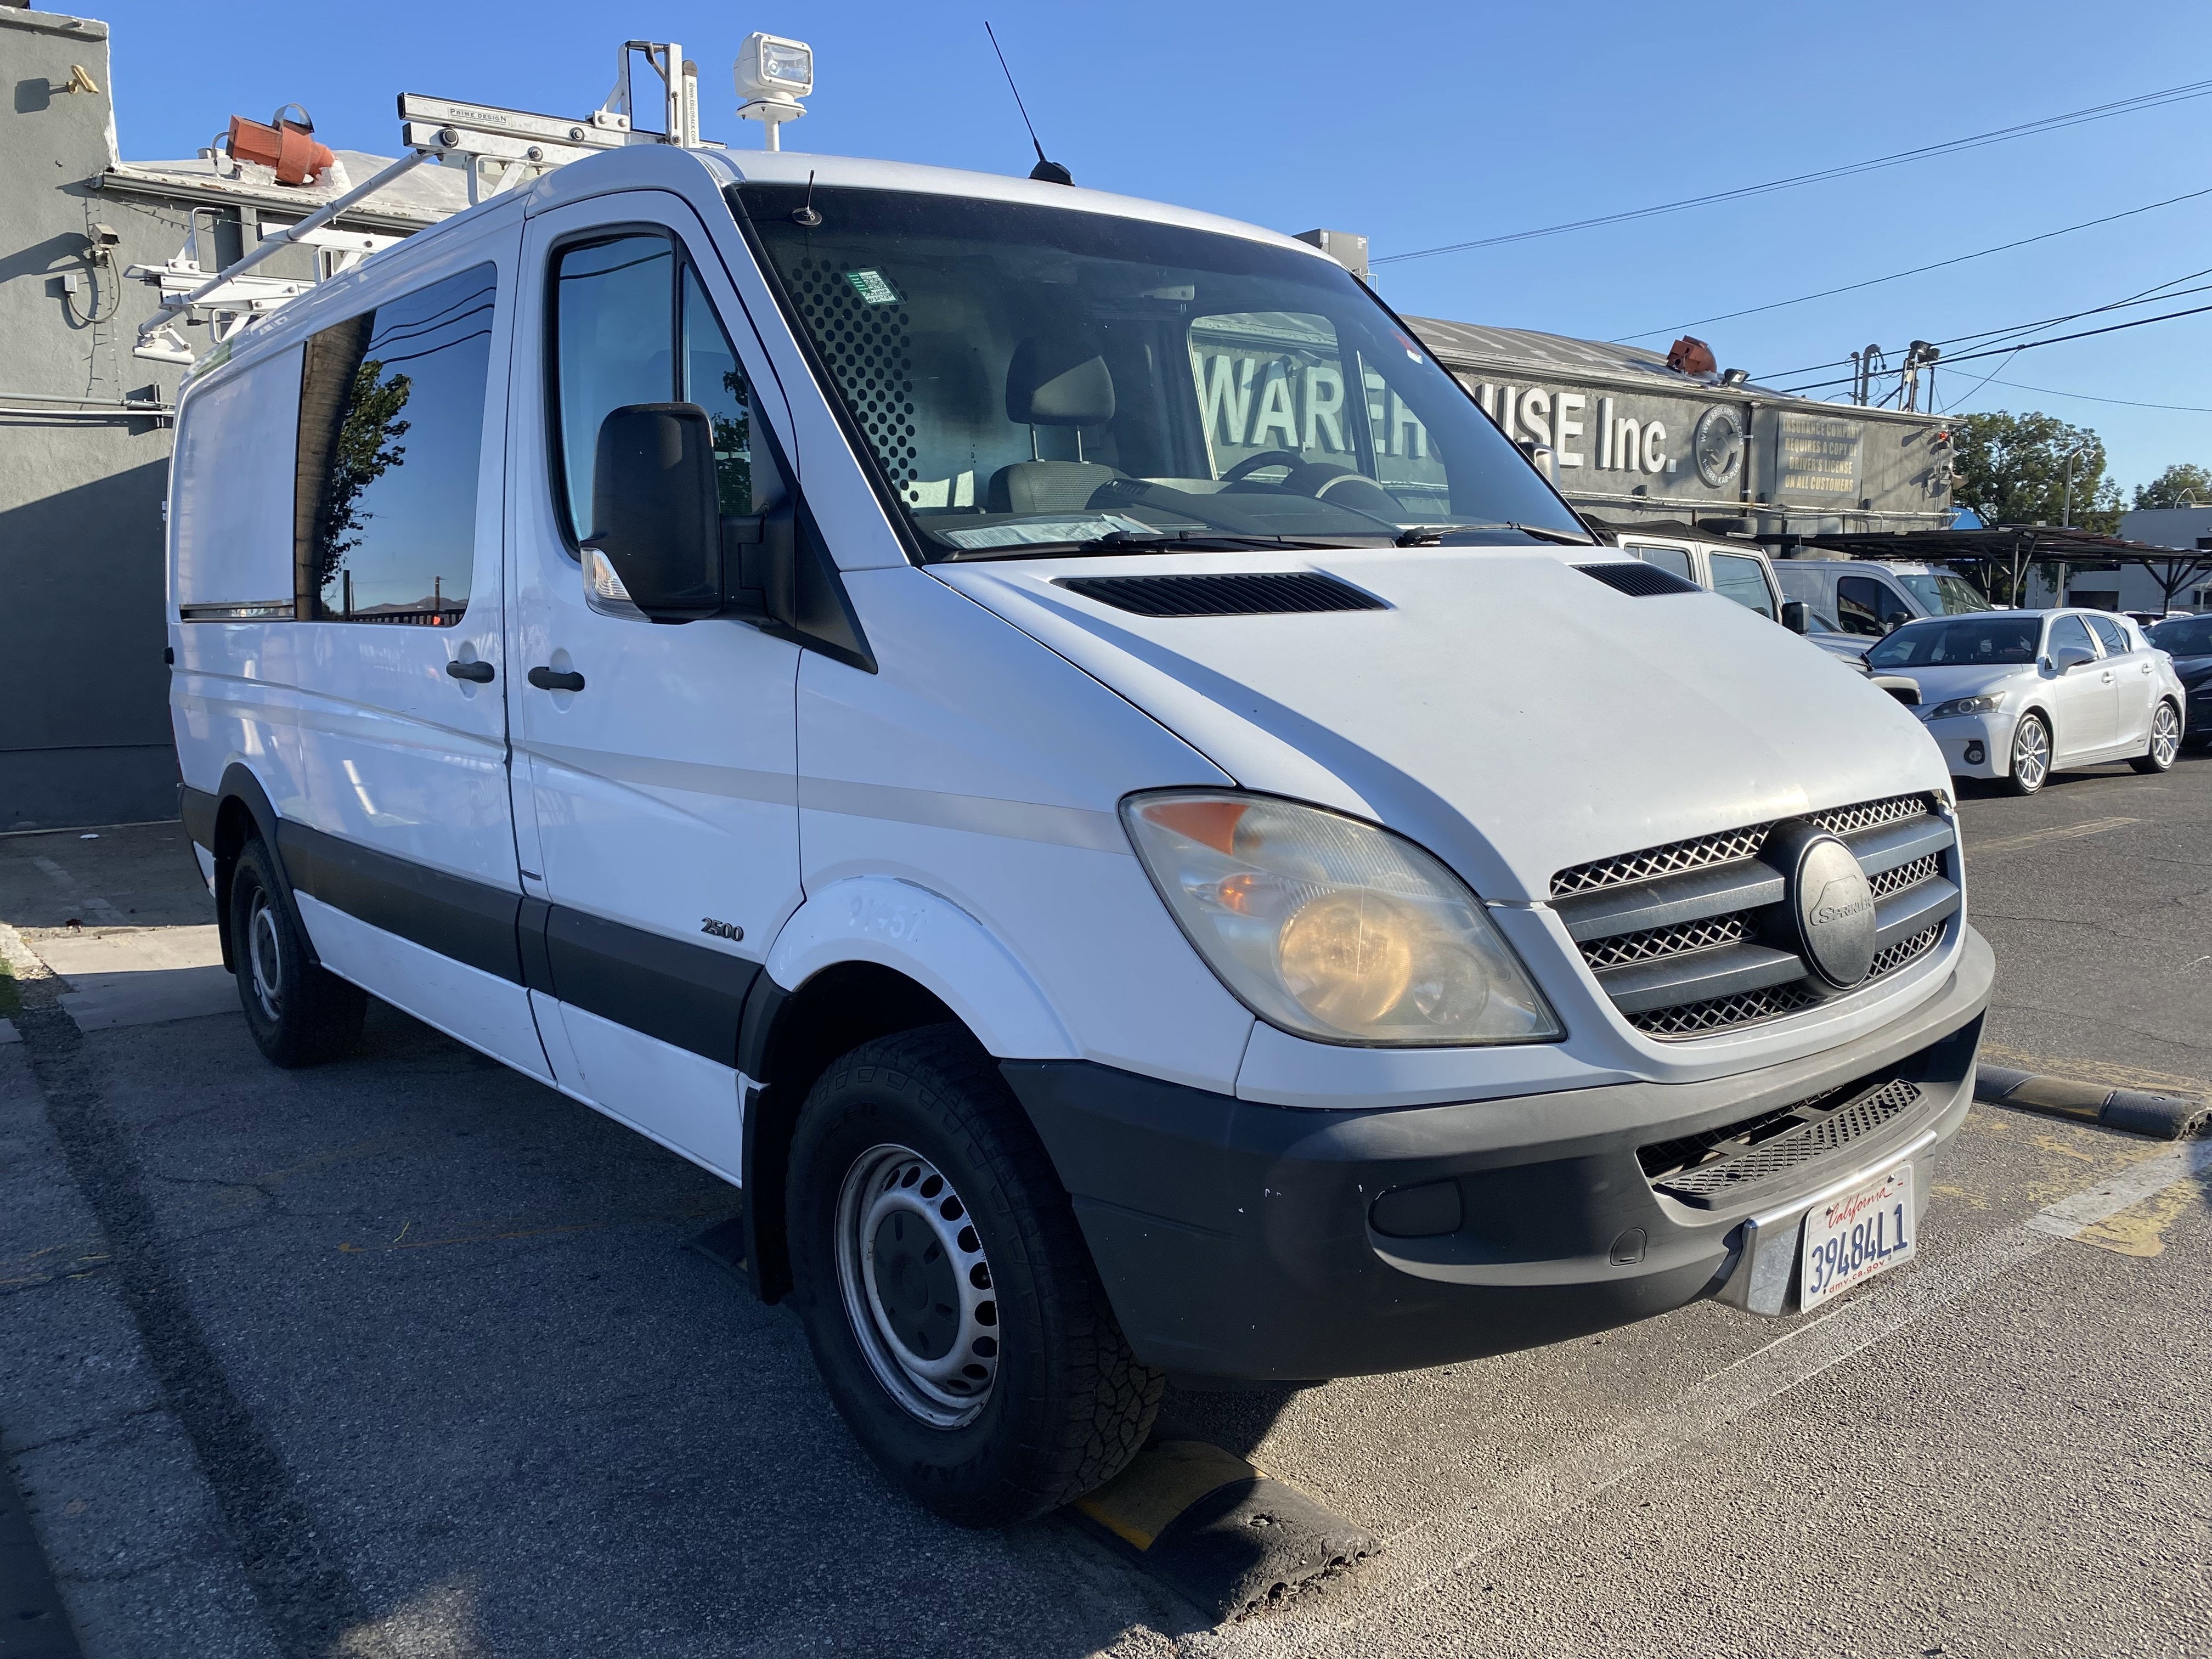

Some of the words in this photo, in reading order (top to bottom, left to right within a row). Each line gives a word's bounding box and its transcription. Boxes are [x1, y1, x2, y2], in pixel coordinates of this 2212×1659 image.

[450, 109, 475, 118] PRIME
[1598, 397, 1677, 473] Inc.
[1701, 407, 1743, 445] WWW.888KARPLUS.COM
[1784, 419, 1825, 436] INSURANCE
[1826, 423, 1860, 439] COMPANY
[1785, 437, 1821, 454] REQUIRES
[1822, 441, 1827, 454] A
[1829, 442, 1848, 456] COPY
[1849, 443, 1858, 457] OF
[1717, 461, 1740, 484] KAR-PLUS
[1789, 456, 1823, 472] DRIVER'S
[1824, 459, 1853, 475] LICENSE
[1785, 474, 1796, 488] ON
[1796, 475, 1809, 489] ALL
[1810, 476, 1854, 493] CUSTOMERS
[701, 917, 744, 941] 2500
[1829, 1187, 1893, 1229] California
[1810, 1203, 1908, 1294] 39484L1
[1829, 1259, 1885, 1294] dmv.ca.gov
